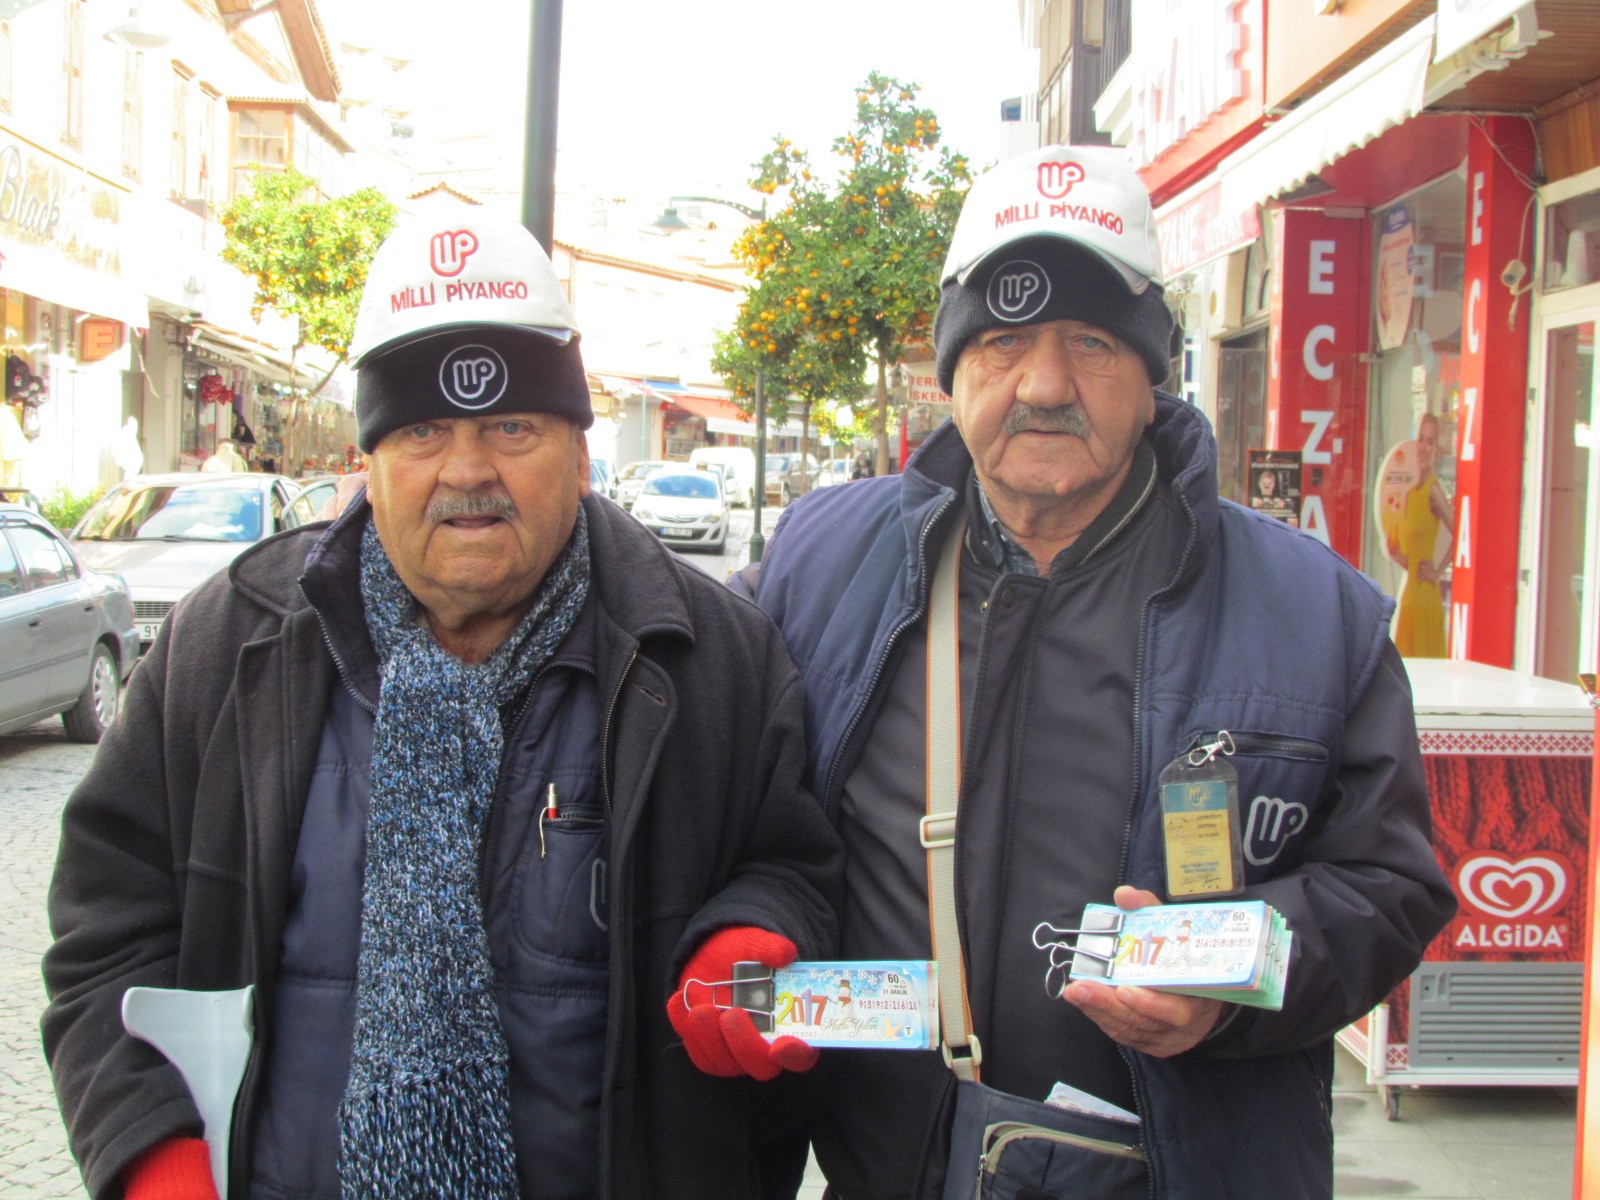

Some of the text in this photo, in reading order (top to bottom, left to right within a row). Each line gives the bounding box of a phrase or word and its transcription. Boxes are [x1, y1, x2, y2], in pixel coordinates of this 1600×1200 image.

[995, 201, 1124, 236] MİLLİ PİYANGO
[390, 279, 528, 314] MİLLİ PİYANGO
[1232, 911, 1245, 921] 60
[1114, 929, 1167, 967] 2017
[887, 973, 900, 984] 60
[775, 987, 828, 1027] 2017
[905, 1026, 911, 1036] T
